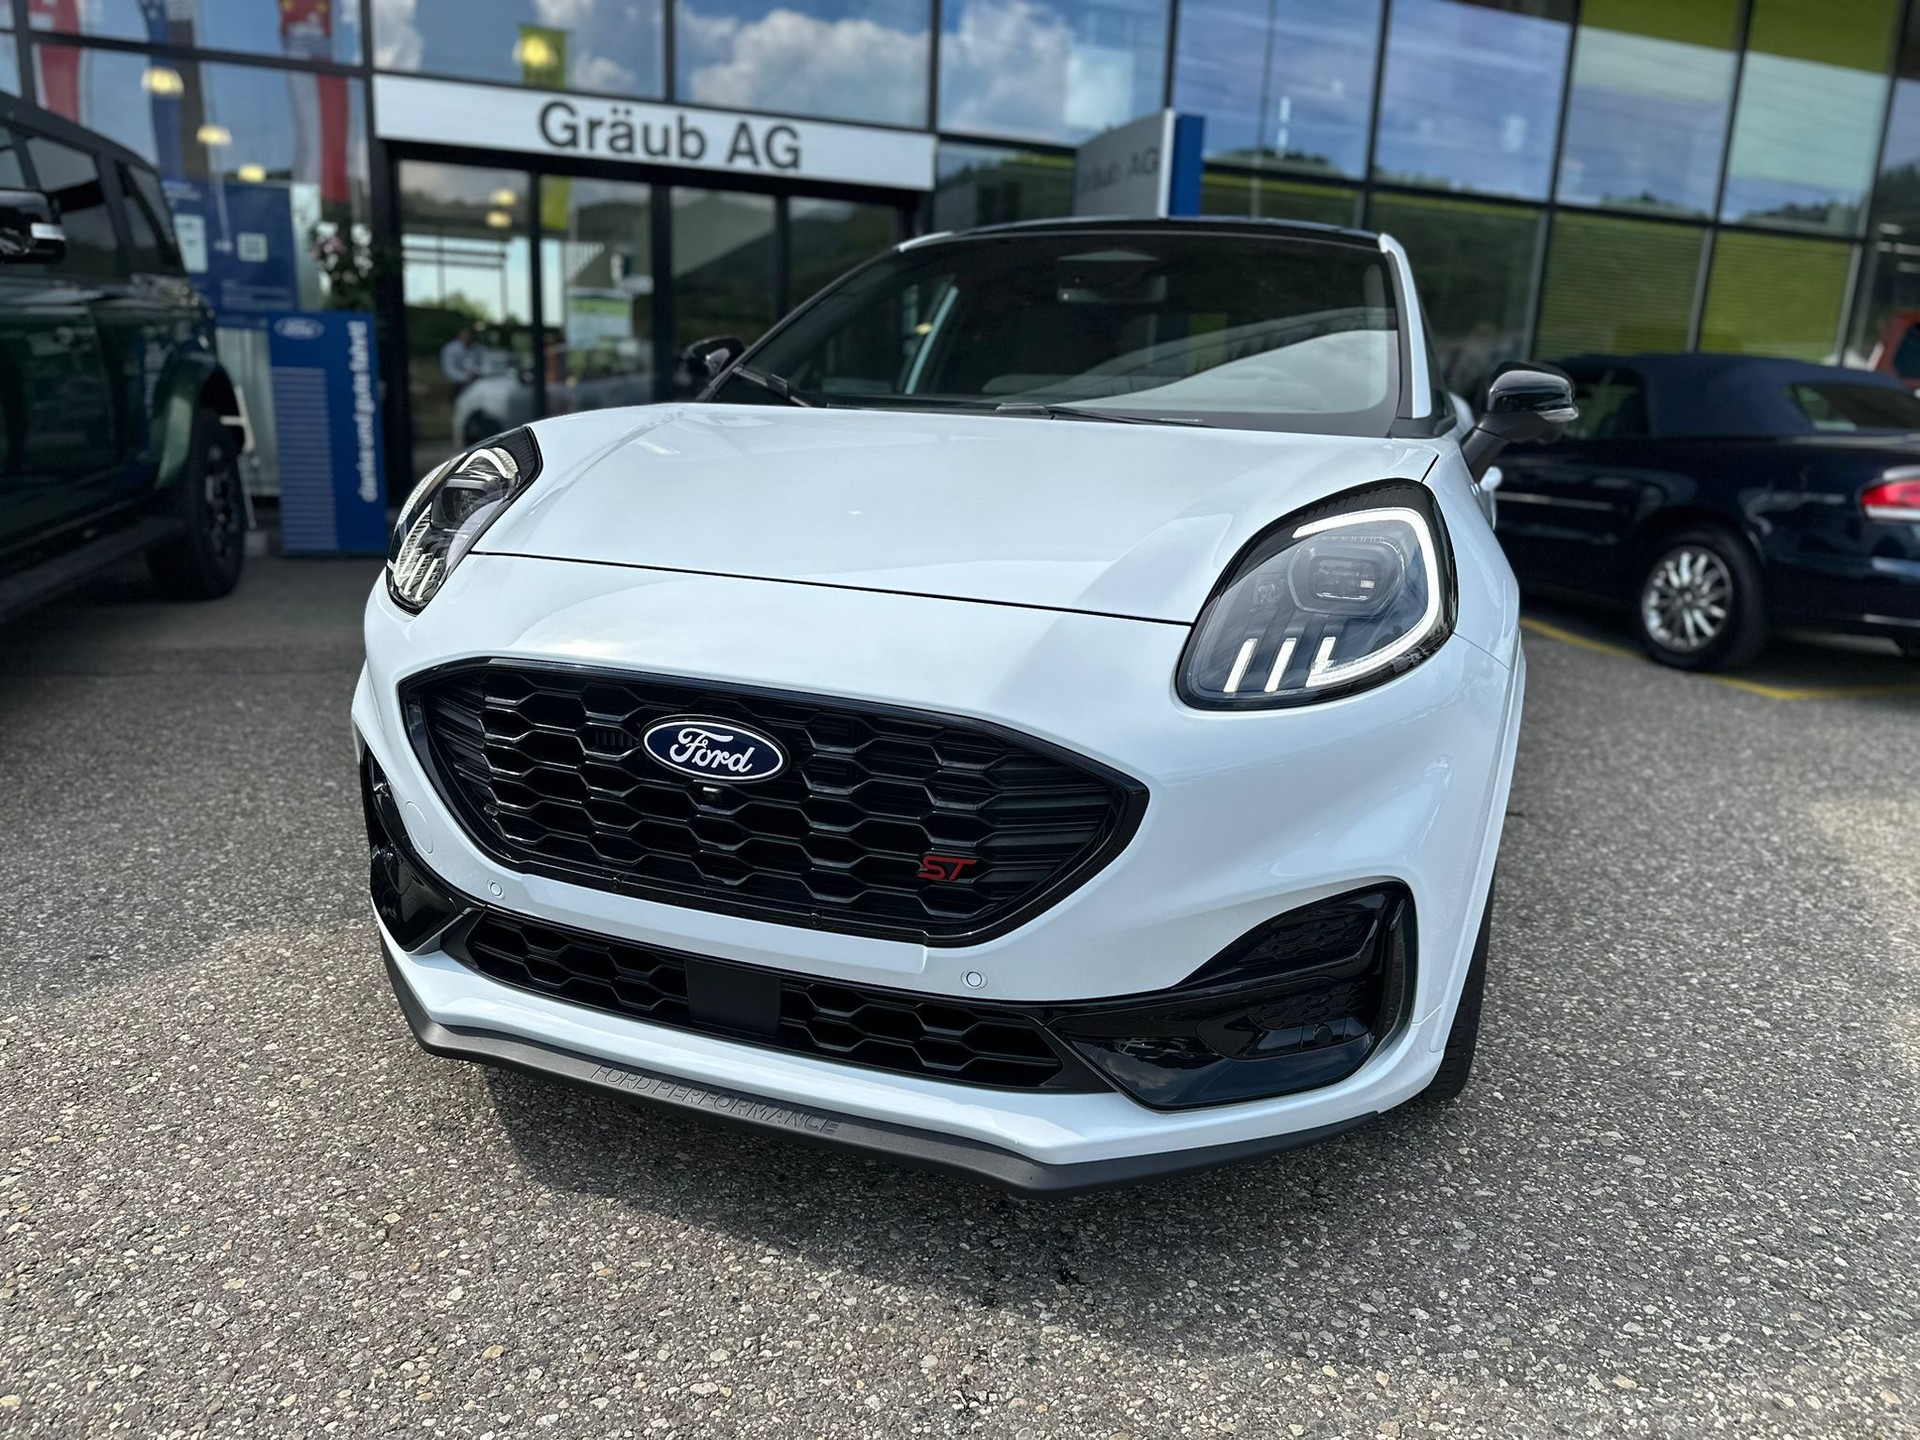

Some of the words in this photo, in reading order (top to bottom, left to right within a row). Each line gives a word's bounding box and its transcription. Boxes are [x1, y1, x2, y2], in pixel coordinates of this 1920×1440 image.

[537, 101, 708, 161] Gräub
[726, 121, 801, 170] AG
[669, 727, 755, 774] Ford
[917, 855, 978, 882] ST
[590, 1064, 651, 1091] FORD
[651, 1080, 841, 1135] PERFORMANCE
